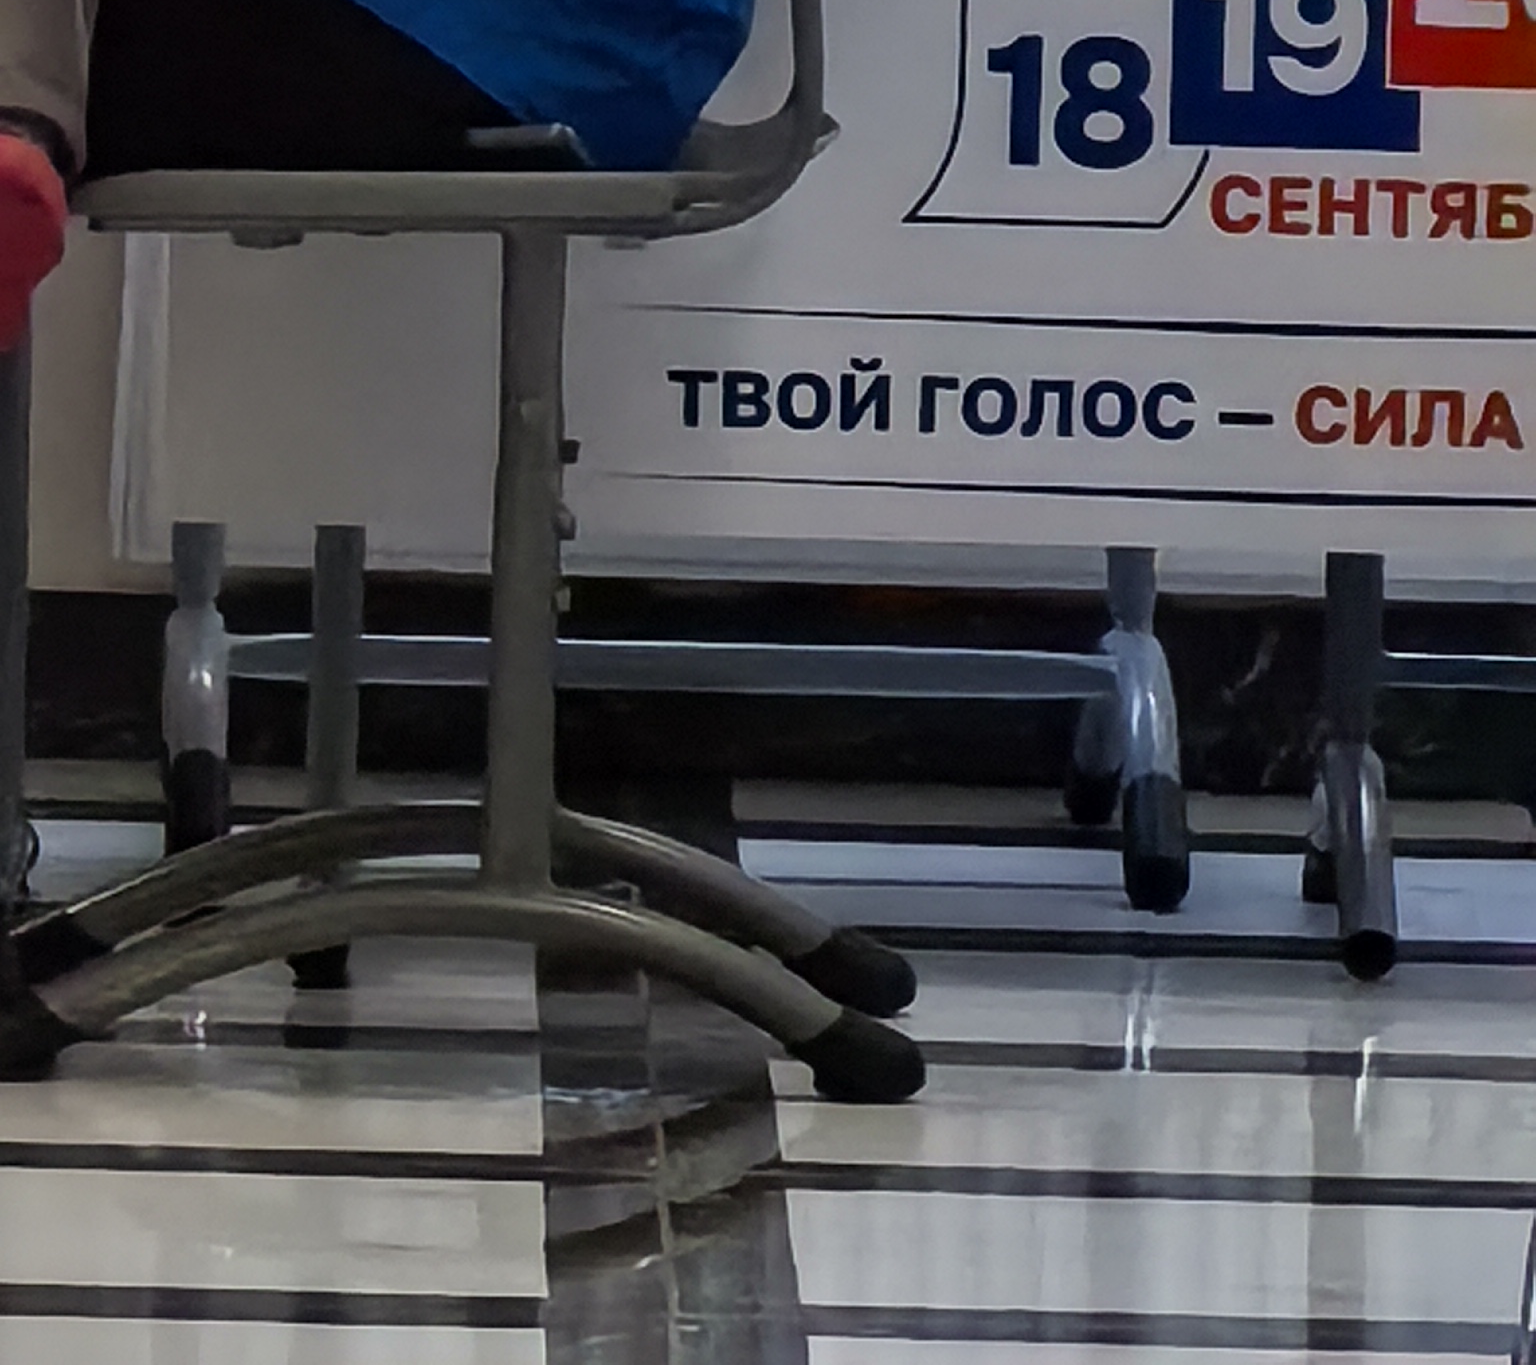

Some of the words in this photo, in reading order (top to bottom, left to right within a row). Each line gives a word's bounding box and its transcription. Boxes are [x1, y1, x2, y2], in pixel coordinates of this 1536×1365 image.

[987, 34, 1154, 170] 18
[1210, 174, 1536, 240] СЕНТЯБ
[666, 357, 892, 432] ТВОЙ
[918, 376, 1197, 441] ГОЛОС
[1295, 385, 1524, 451] СИЛА
